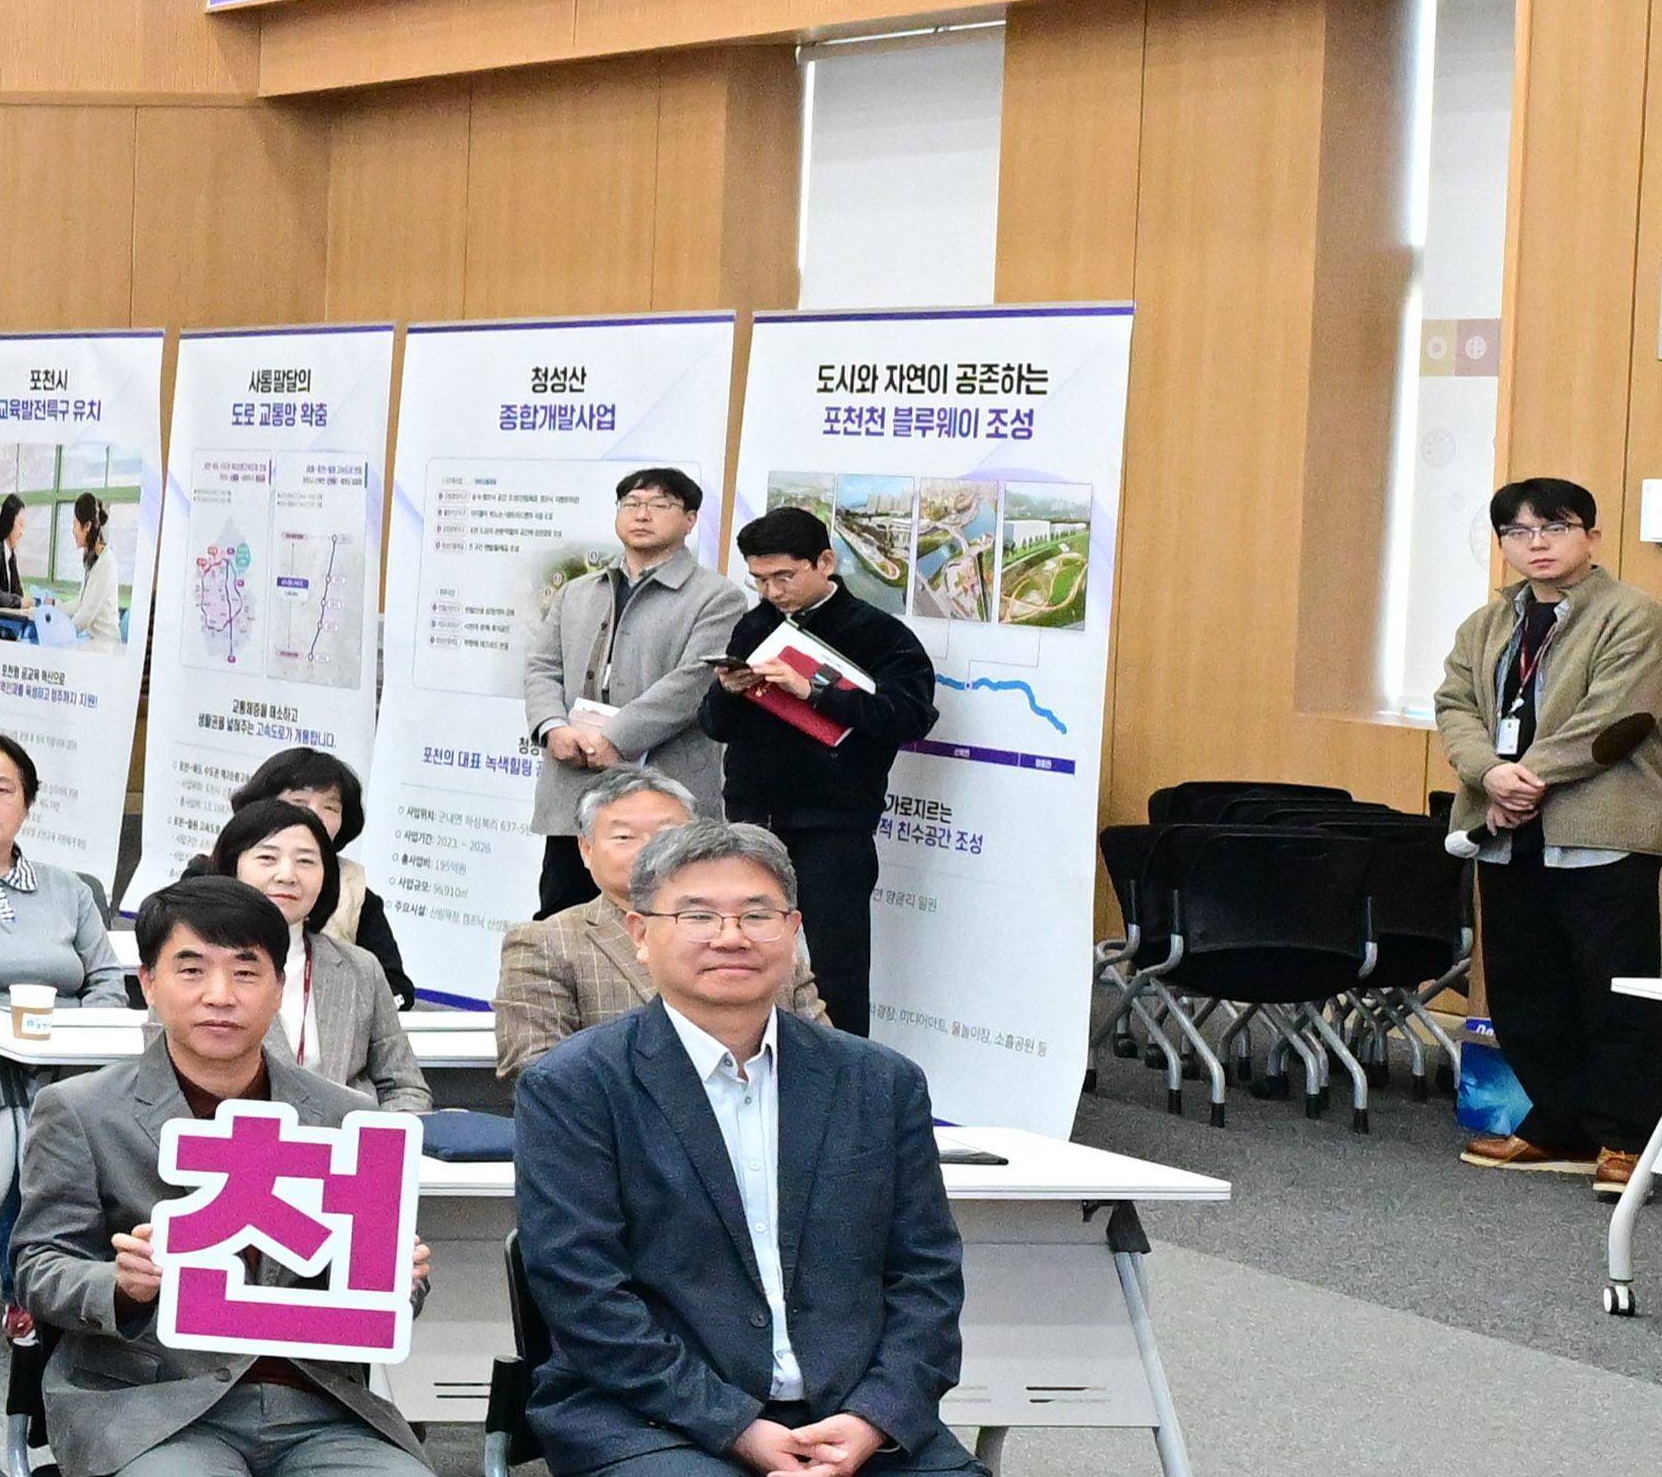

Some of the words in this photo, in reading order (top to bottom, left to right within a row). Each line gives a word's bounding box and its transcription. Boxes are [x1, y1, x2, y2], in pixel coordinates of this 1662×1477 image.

[29, 369, 68, 391] 포천시
[249, 368, 312, 394] 사통팔달의
[531, 367, 587, 394] 청성산
[816, 363, 878, 395] 도시와
[884, 363, 948, 395] 자연이
[955, 363, 1049, 396] 공존하는
[72, 399, 101, 422] 유치
[231, 401, 256, 426] 도로
[258, 401, 297, 426] 교통망
[300, 401, 328, 427] 확충
[499, 404, 616, 432] 종합개발사업
[822, 405, 886, 436] 포천천
[892, 406, 979, 438] 블루웨이
[985, 408, 1034, 440] 조성
[256, 722, 293, 741] 고속도로가
[423, 746, 454, 766] 포천의
[458, 751, 481, 769] 대표
[485, 754, 532, 777] 녹색힐링
[886, 793, 953, 824] 가로지르는
[897, 821, 951, 849] 친수공간
[955, 830, 983, 855] 조성
[165, 1115, 408, 1350] 천
